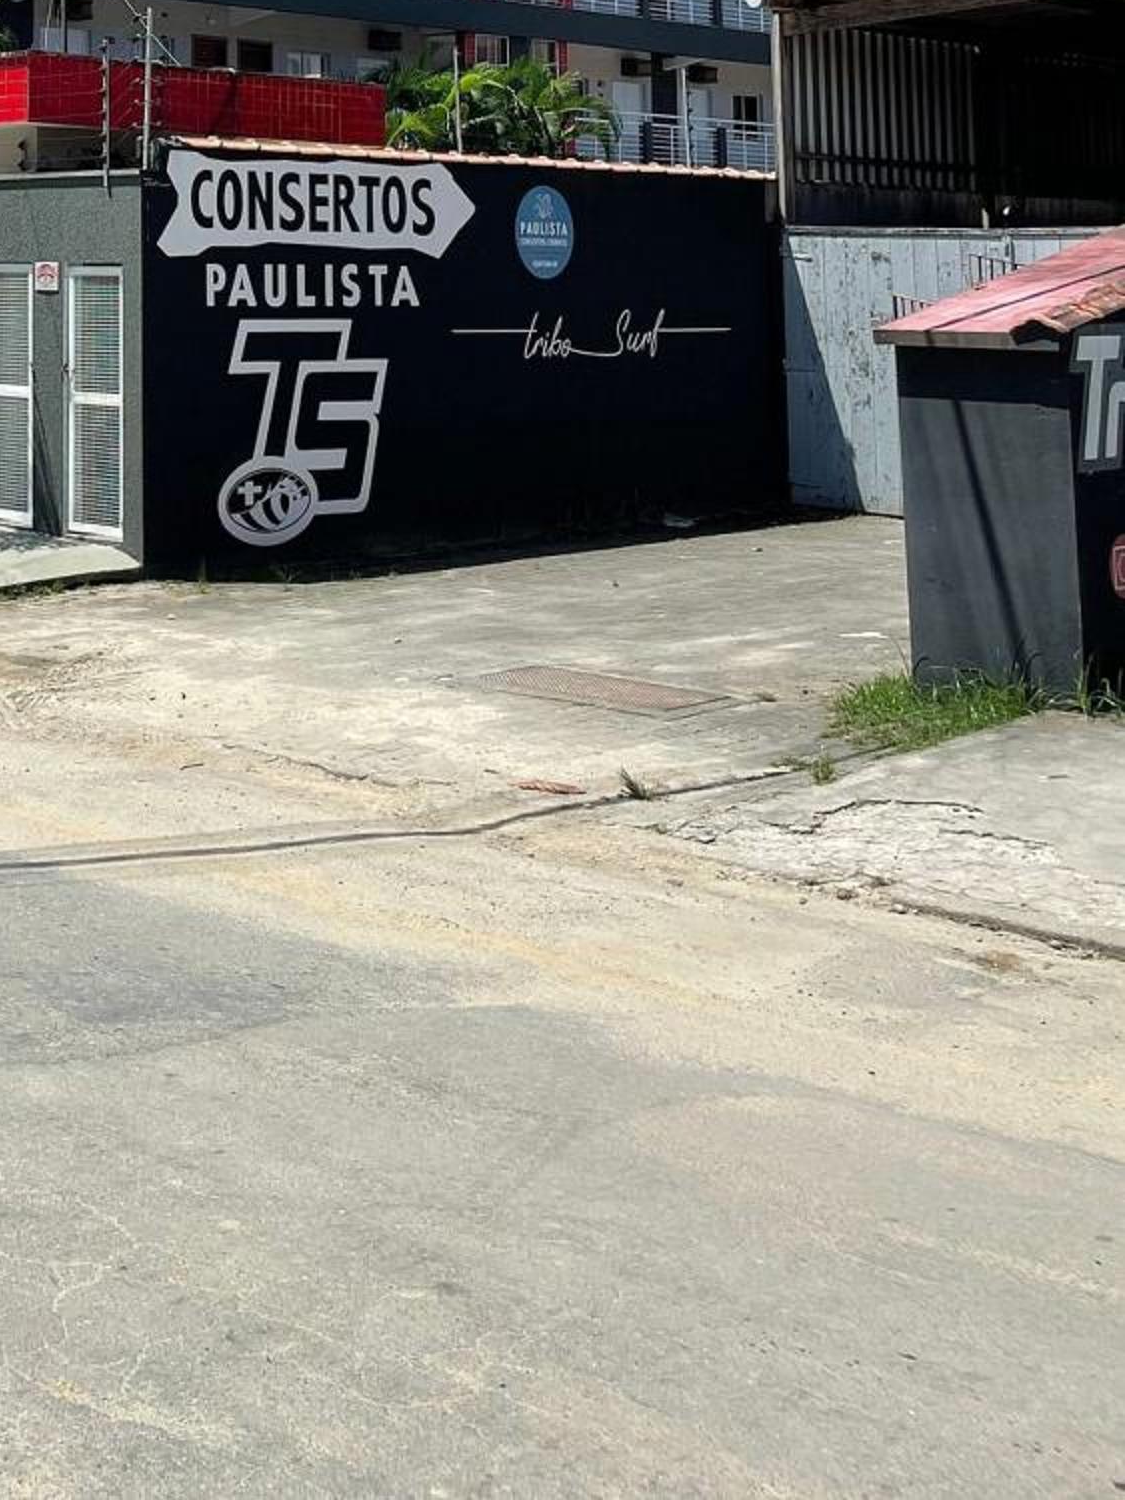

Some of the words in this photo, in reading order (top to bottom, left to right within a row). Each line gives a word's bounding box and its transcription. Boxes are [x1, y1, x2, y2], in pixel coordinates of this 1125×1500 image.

[190, 169, 436, 237] CONSERTOS
[520, 221, 568, 236] PAULISTA
[205, 263, 421, 308] PAULISTA
